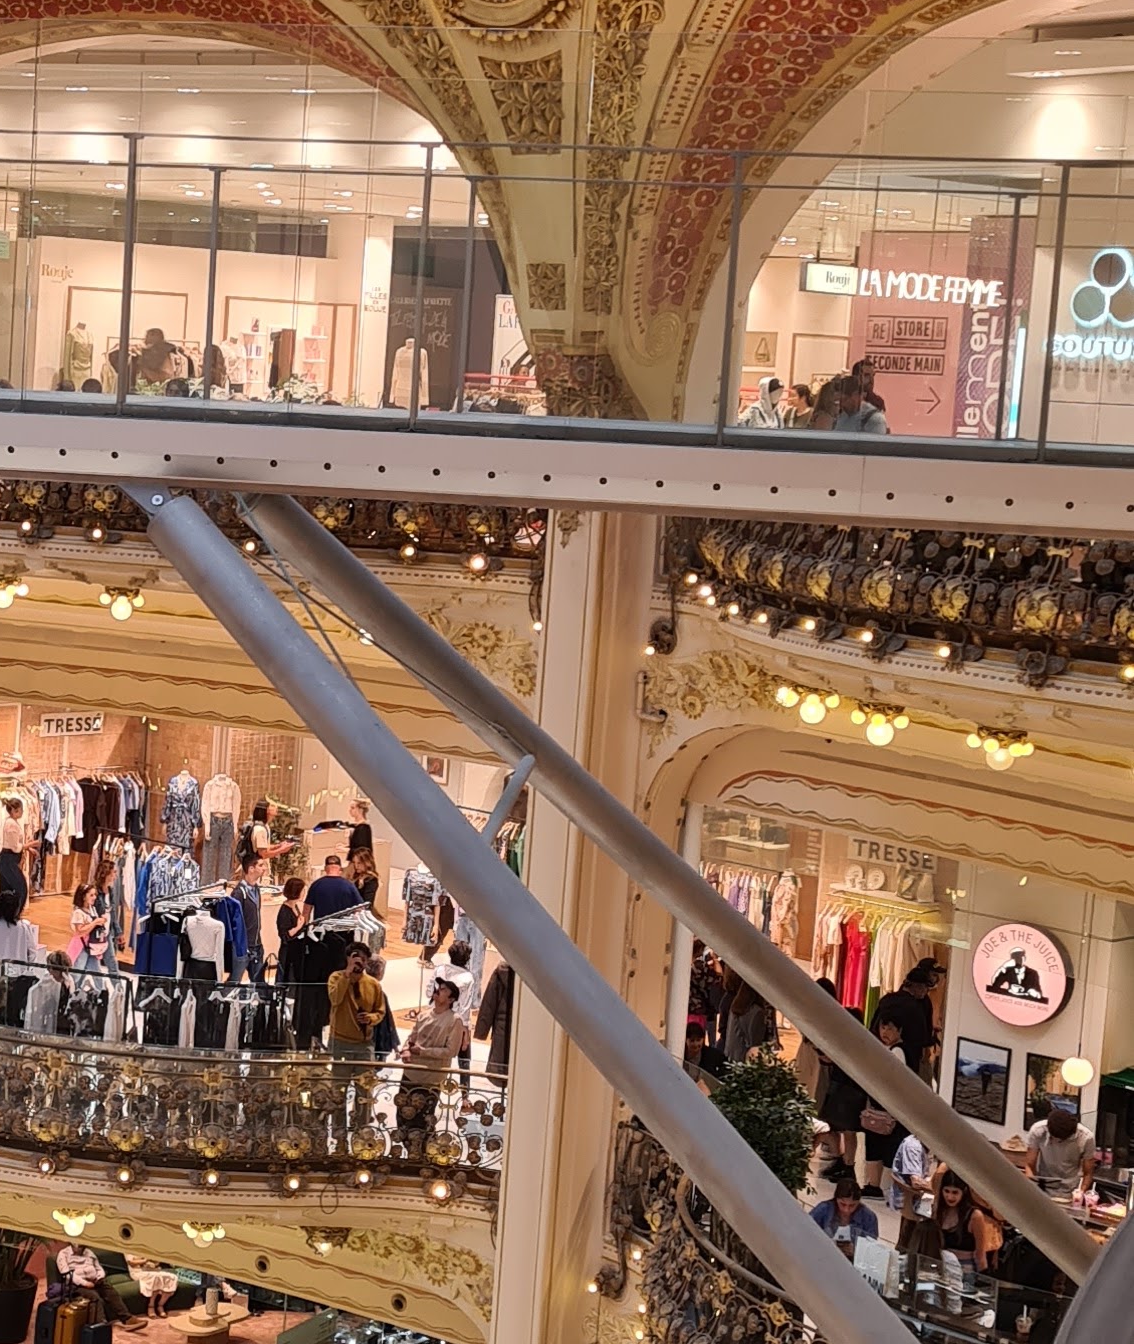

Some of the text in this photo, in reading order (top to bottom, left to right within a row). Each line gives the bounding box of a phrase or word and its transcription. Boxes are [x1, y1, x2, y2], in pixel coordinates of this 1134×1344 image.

[41, 264, 74, 281] Rouje
[859, 268, 1003, 306] LA MODE FEMME
[896, 320, 930, 336] STORE
[914, 357, 941, 372] MAIN
[981, 929, 1060, 973] JOE & THE JUICE
